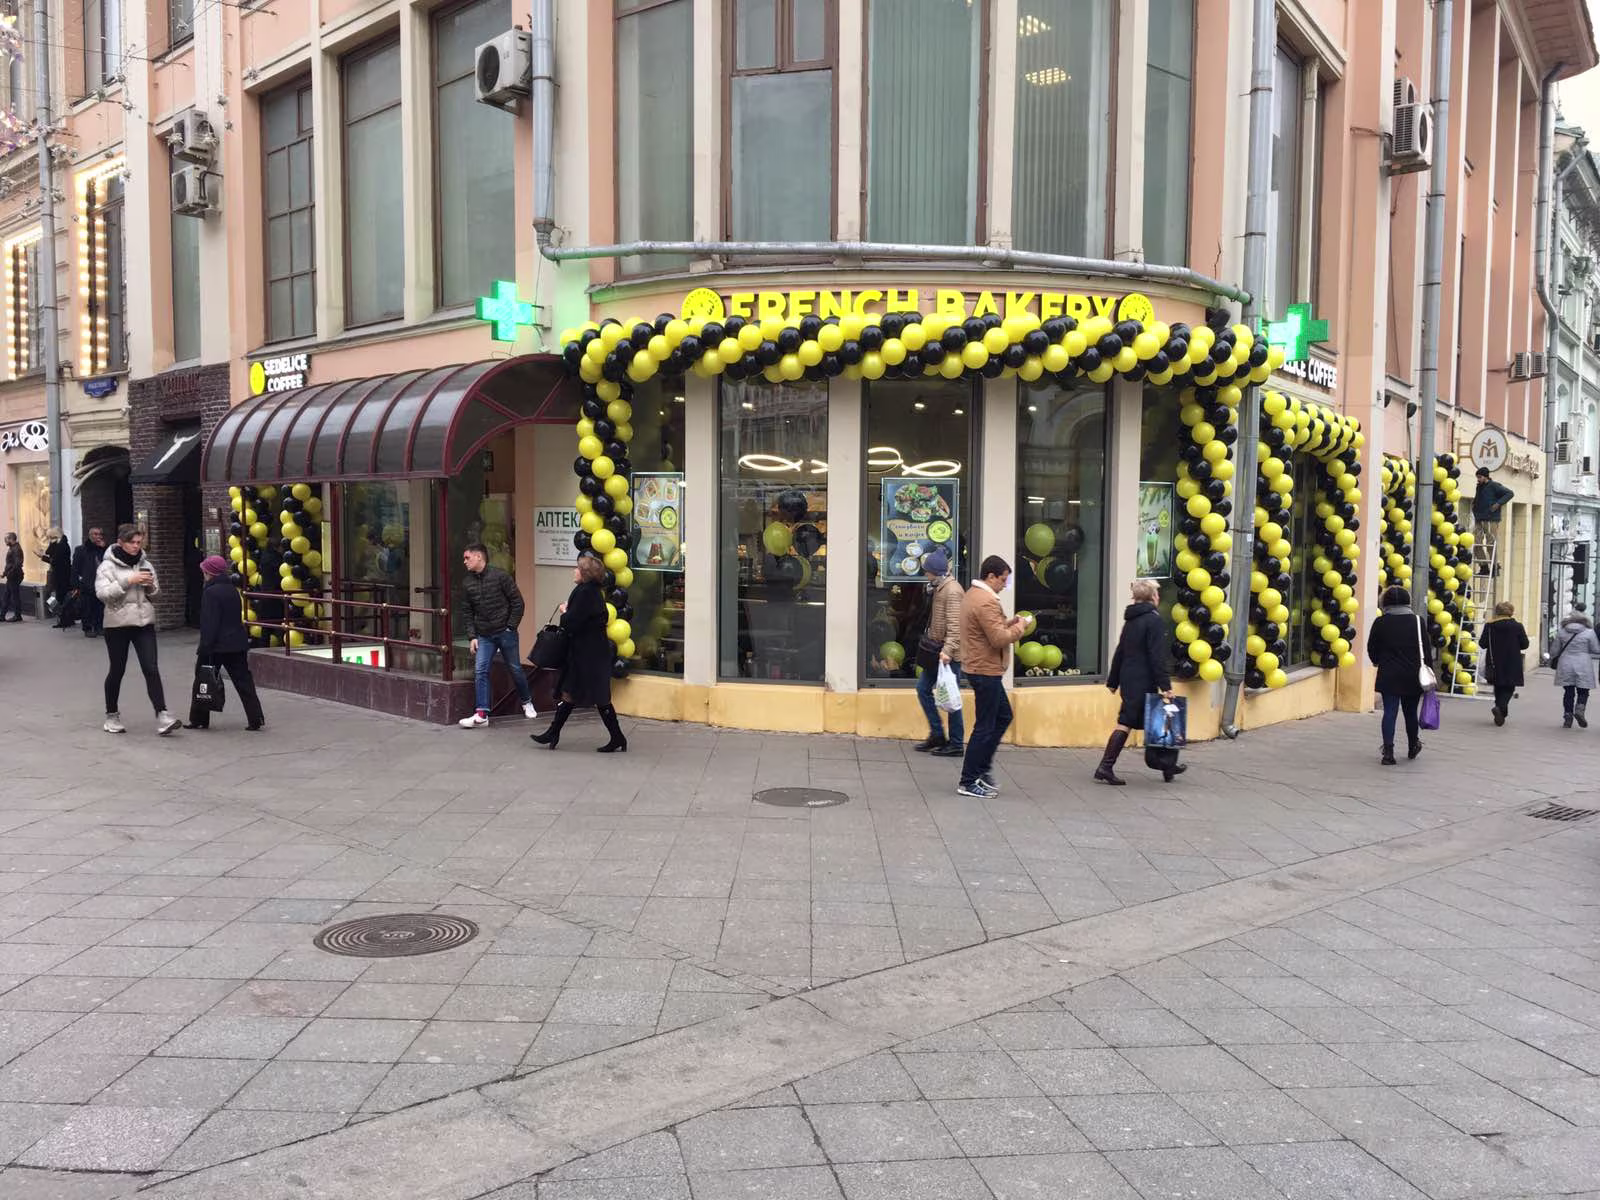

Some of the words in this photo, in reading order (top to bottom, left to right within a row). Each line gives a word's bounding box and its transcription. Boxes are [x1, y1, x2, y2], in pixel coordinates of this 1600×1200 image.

[731, 289, 919, 320] FRENCH
[264, 354, 308, 375] SEDELICE
[1308, 358, 1337, 388] COFFEE
[267, 374, 303, 392] COFFEE
[536, 511, 581, 528] АПТЕК
